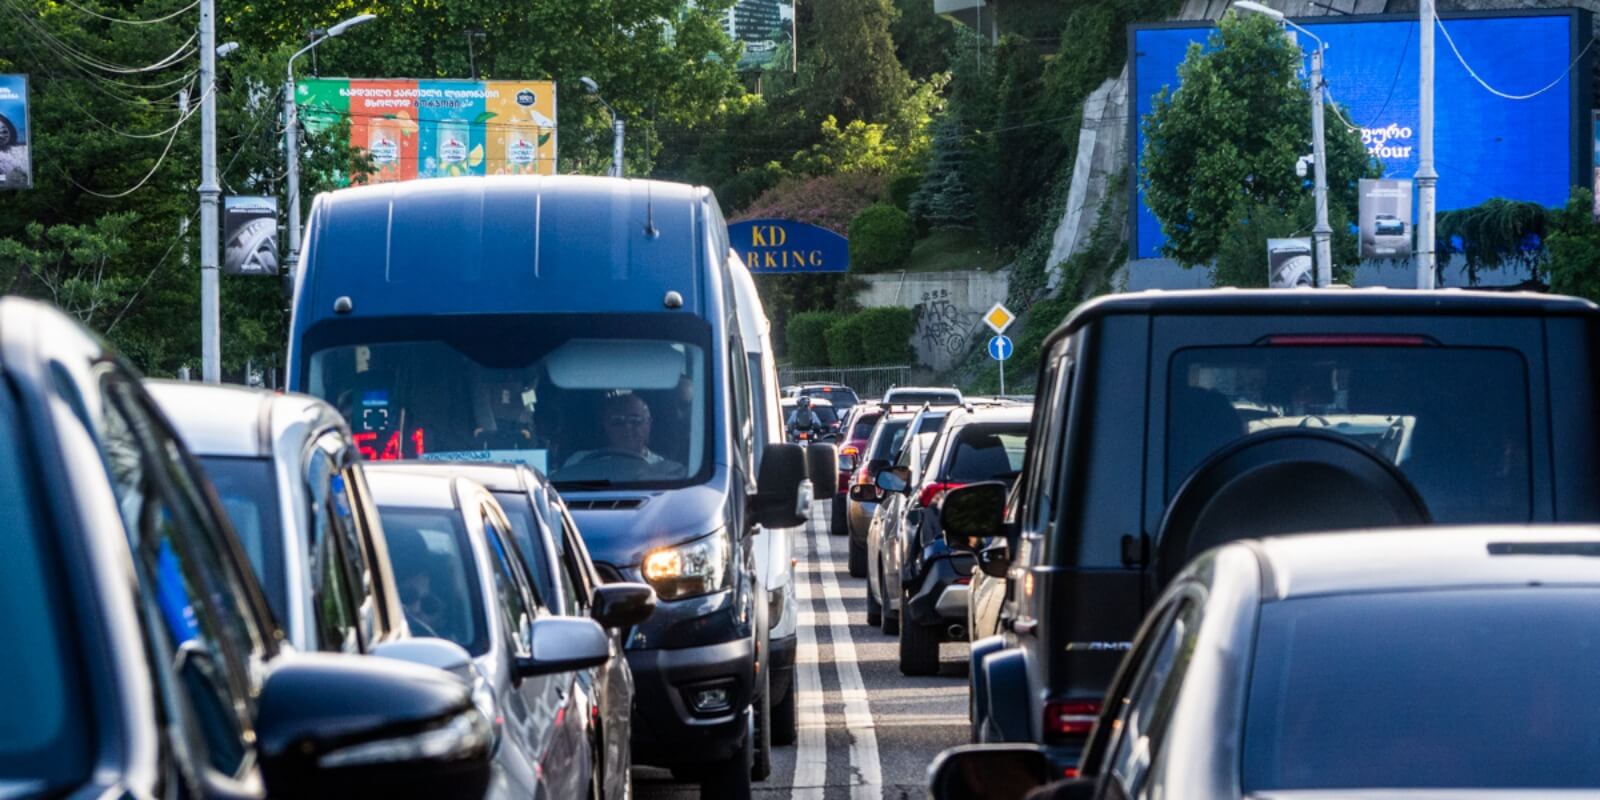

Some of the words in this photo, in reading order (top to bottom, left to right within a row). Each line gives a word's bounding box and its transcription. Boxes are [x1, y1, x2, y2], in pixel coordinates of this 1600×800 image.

[752, 225, 786, 247] KD
[747, 249, 823, 268] RKING
[352, 427, 424, 461] 541
